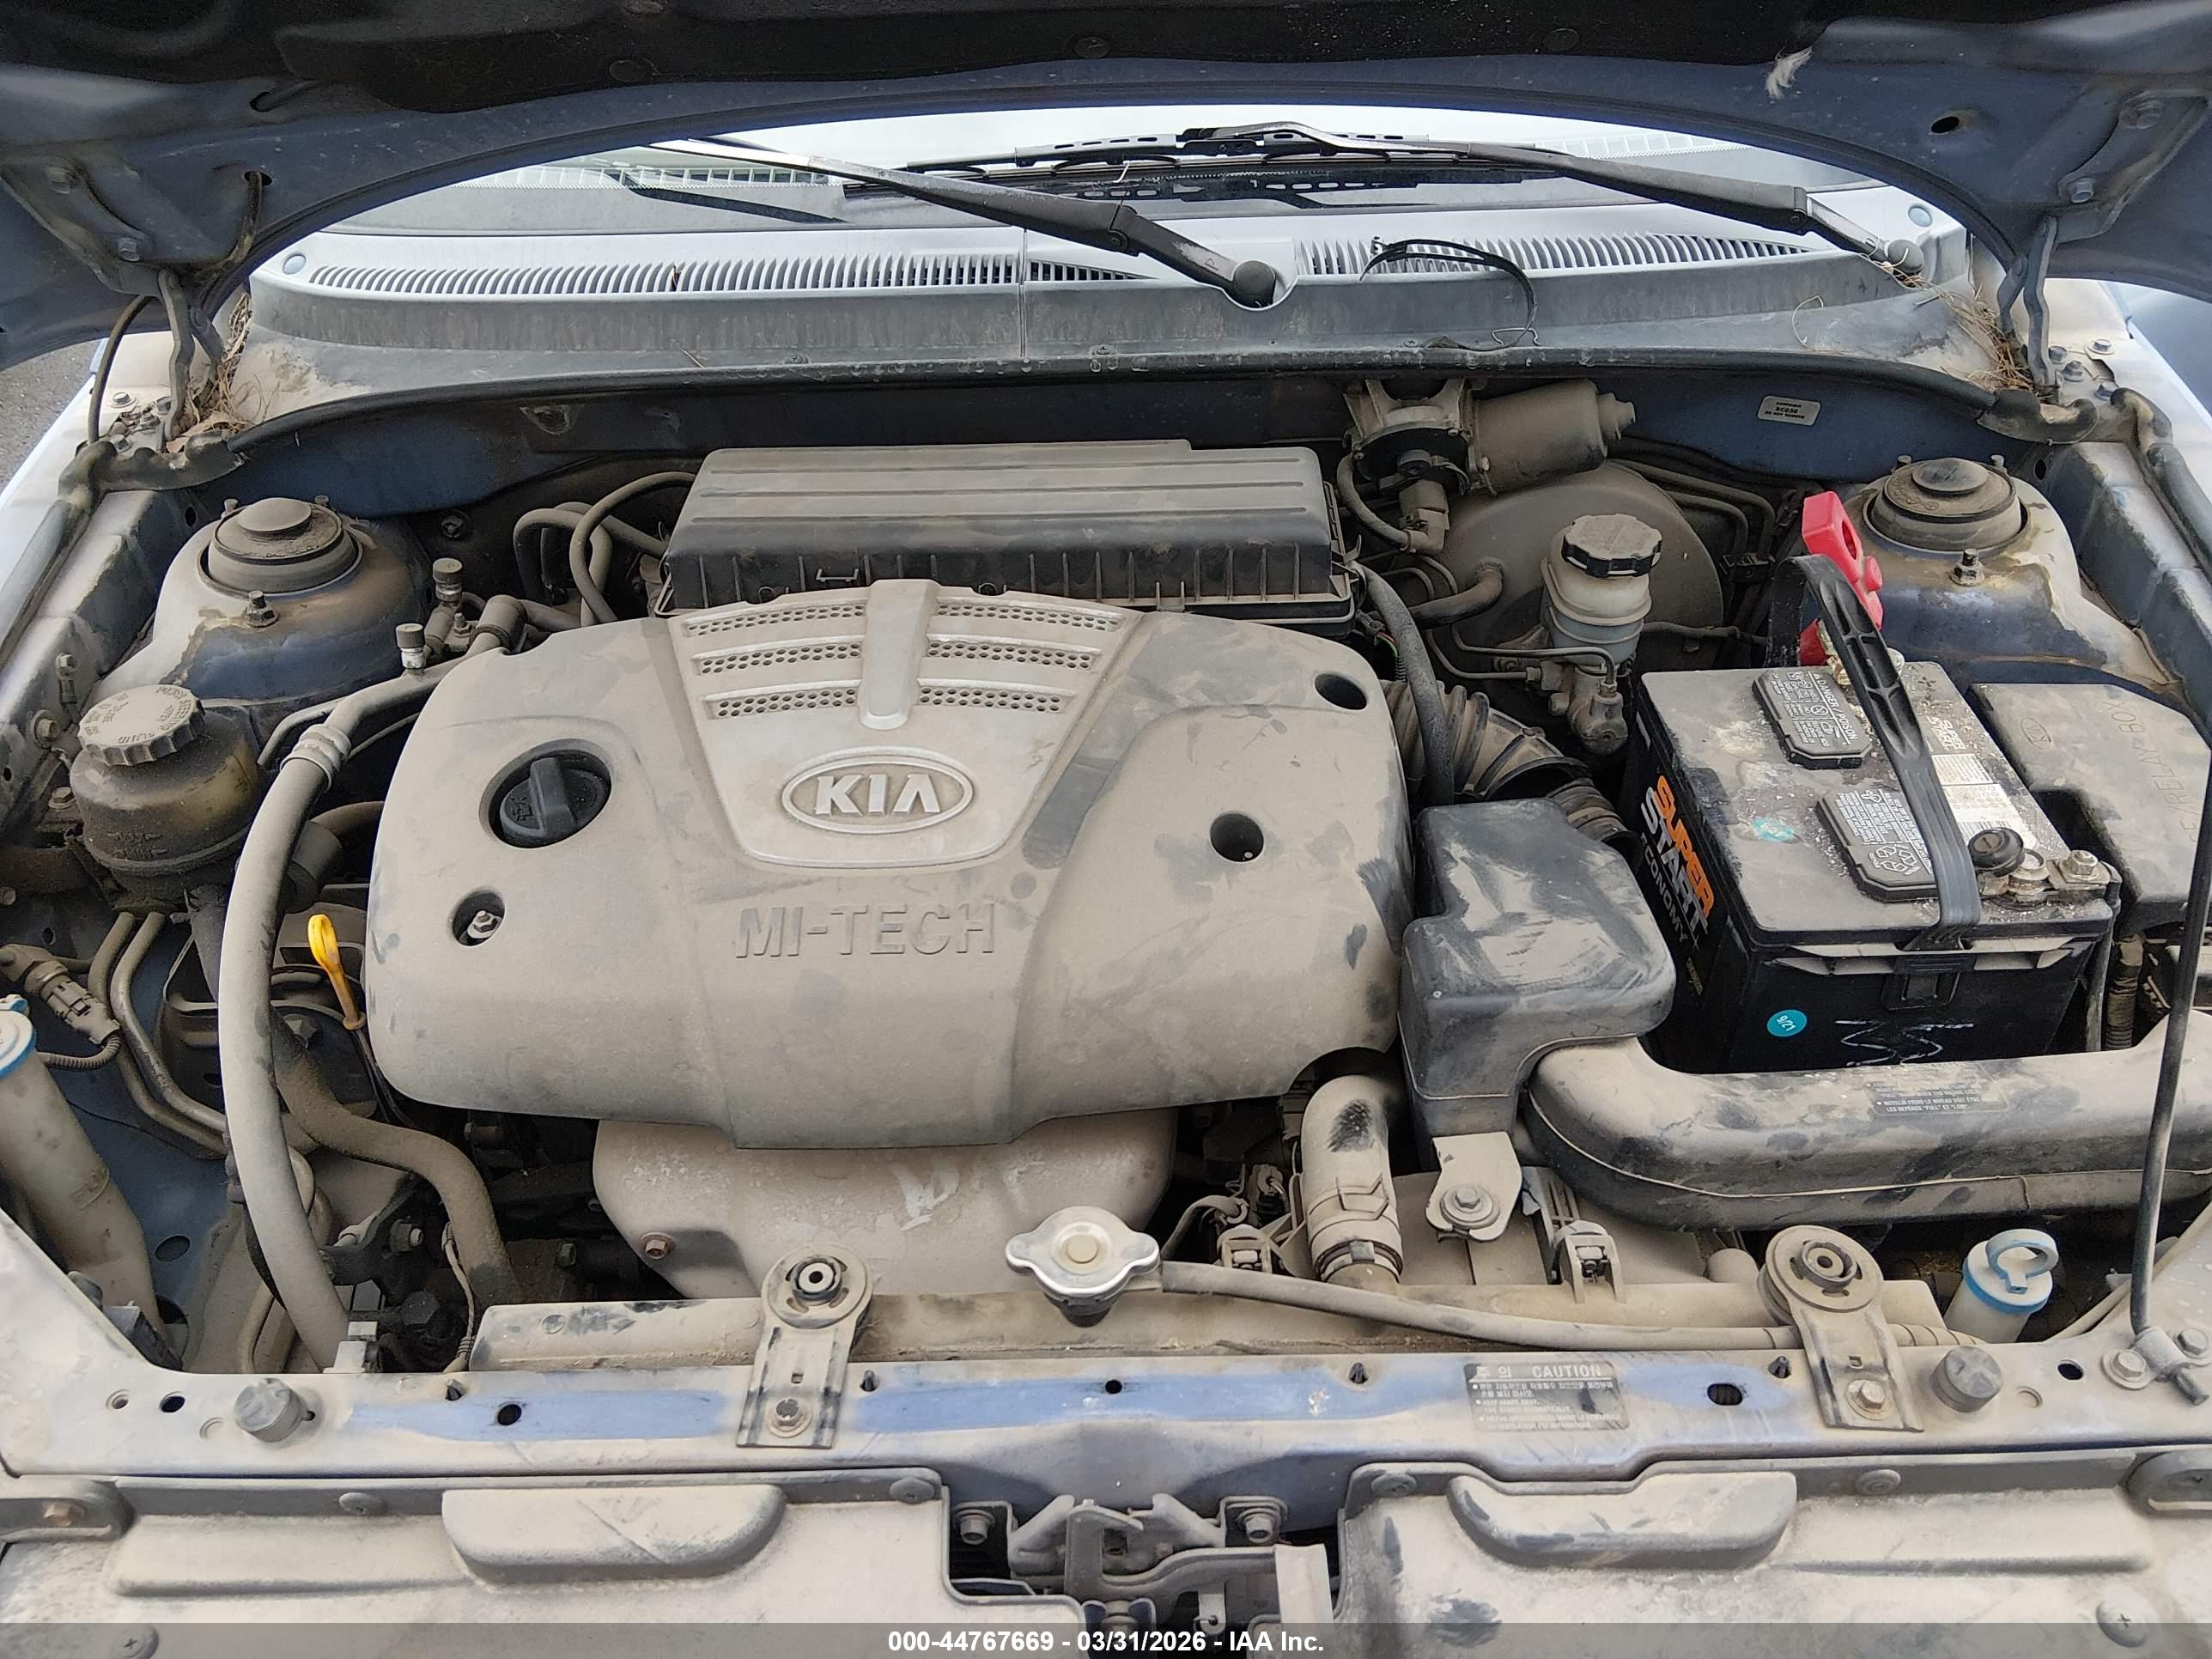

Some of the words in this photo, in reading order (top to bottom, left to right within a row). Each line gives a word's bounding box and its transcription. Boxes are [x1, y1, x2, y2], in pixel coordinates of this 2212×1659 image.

[1817, 679, 1839, 709] DANGER
[1836, 713, 1859, 740] POISON
[814, 773, 942, 817] KIA
[1641, 786, 1709, 934] START
[1655, 775, 1714, 918] SUPER
[736, 903, 999, 959] MI-TECH
[1776, 1015, 1796, 1031] 9/21
[1532, 1364, 1601, 1378] CAUTION
